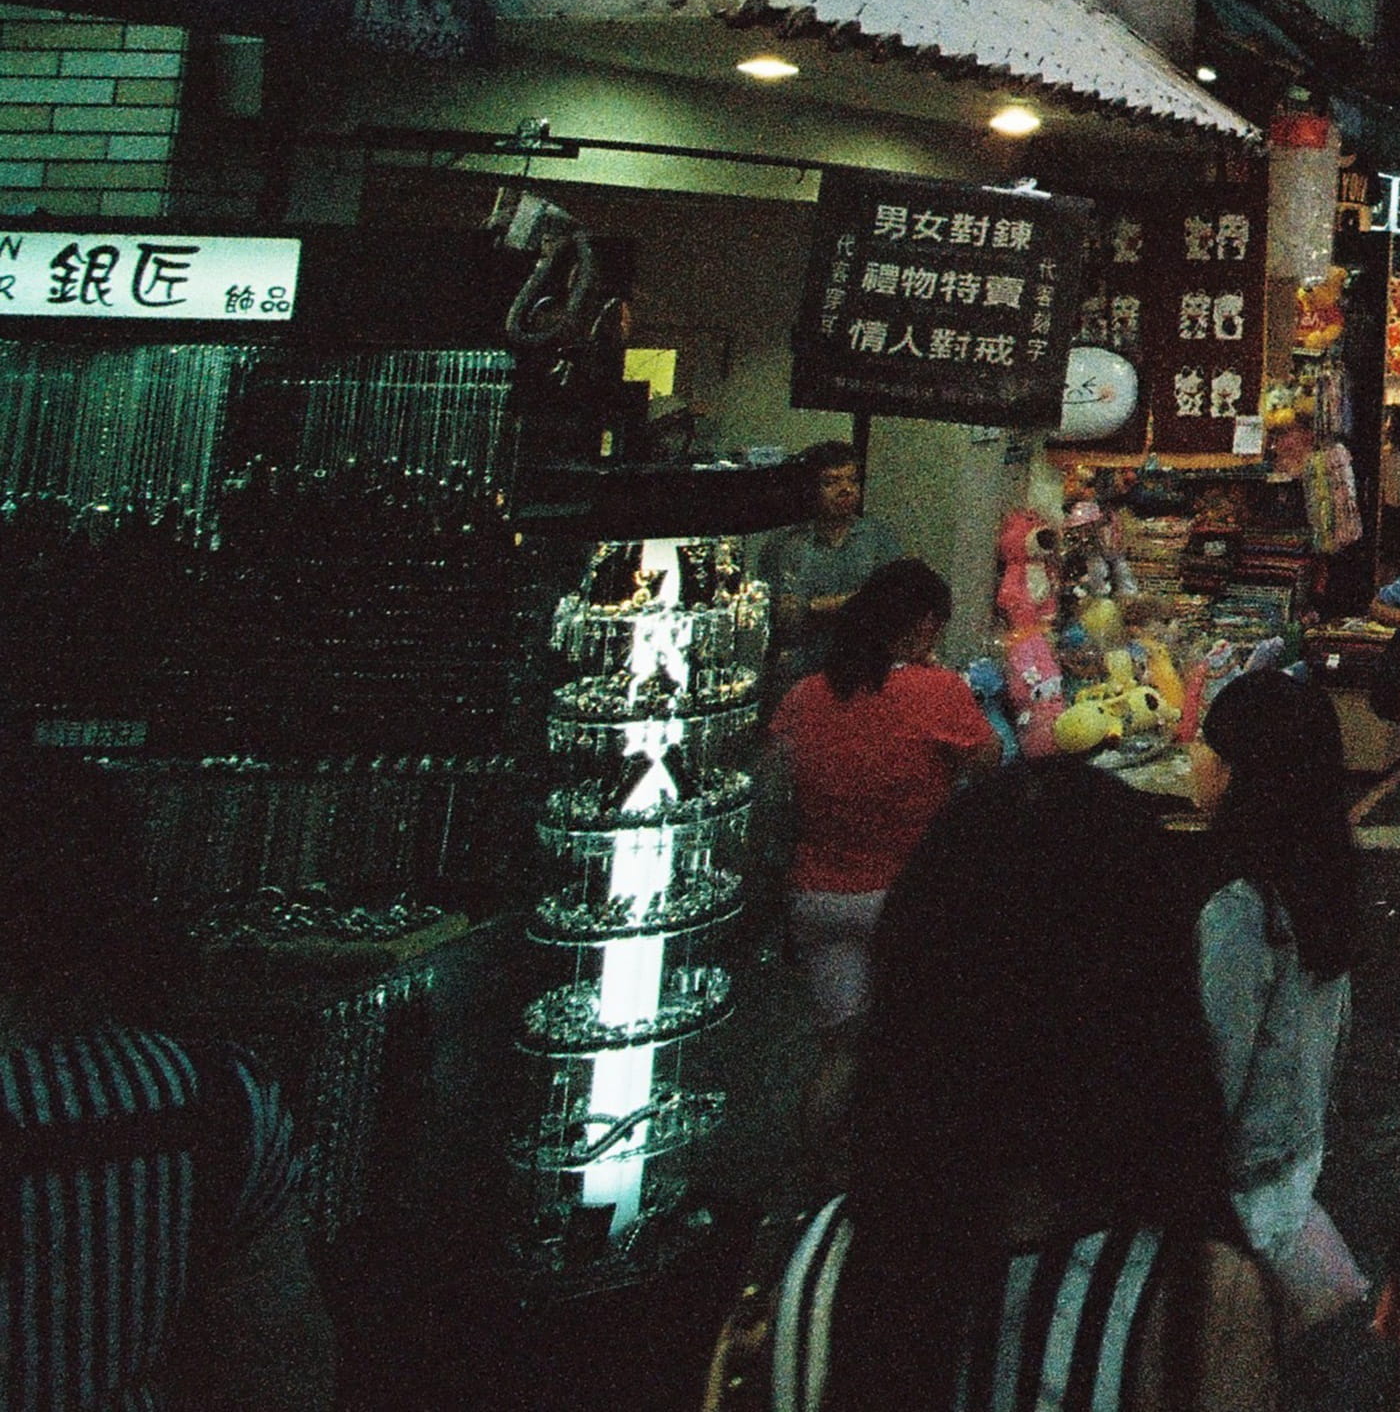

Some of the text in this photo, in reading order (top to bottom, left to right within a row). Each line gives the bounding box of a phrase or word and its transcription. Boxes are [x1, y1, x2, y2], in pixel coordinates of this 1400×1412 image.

[47, 241, 201, 307] 銀匠
[860, 261, 1026, 310] 禮物特賣
[225, 284, 291, 314] 飾品
[847, 318, 1017, 367] 情人對戒
